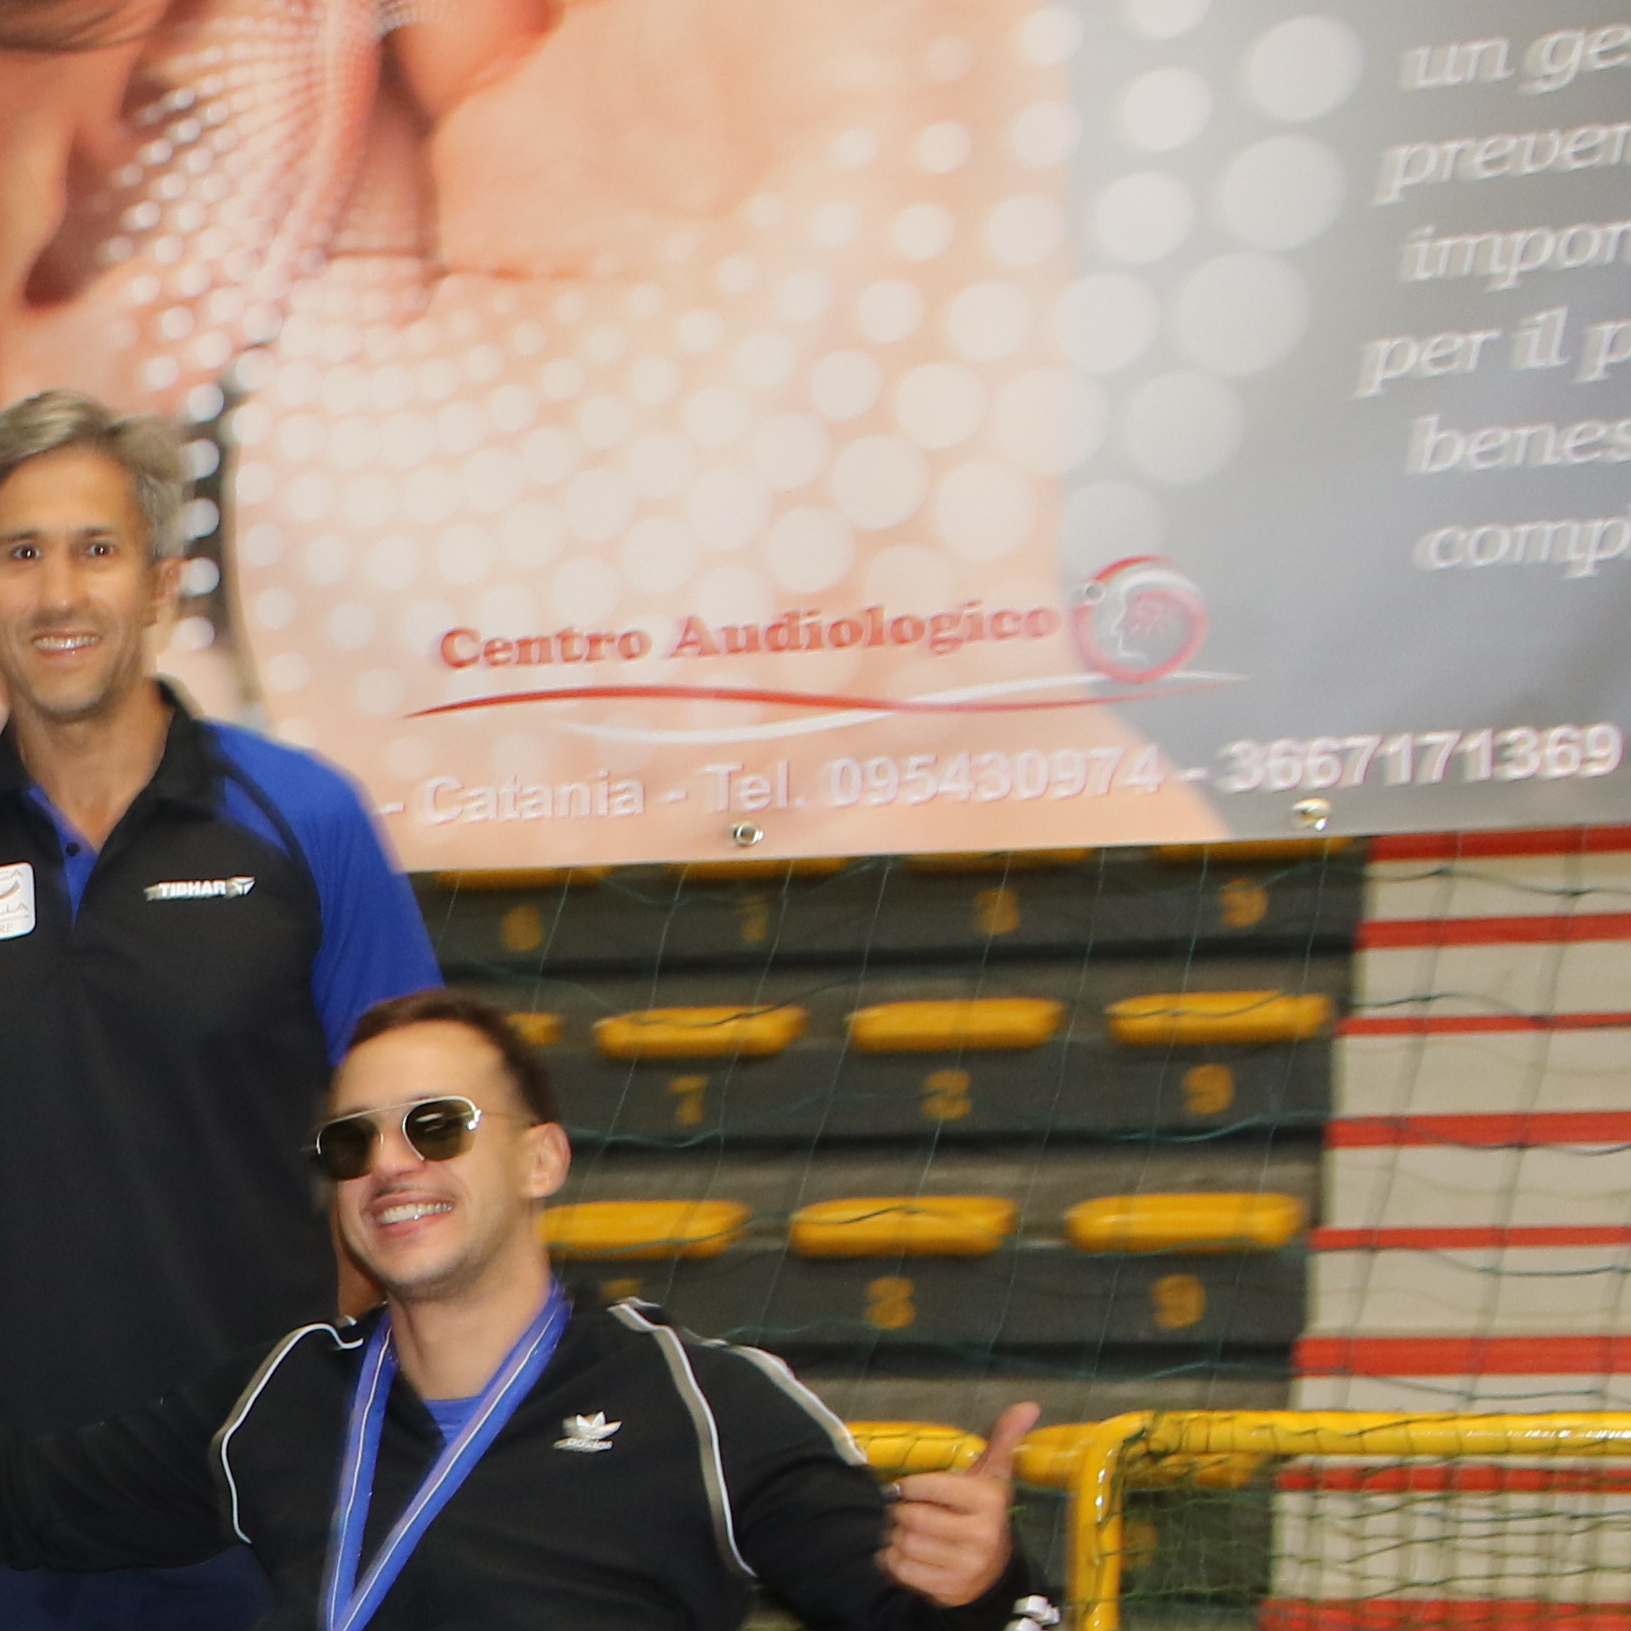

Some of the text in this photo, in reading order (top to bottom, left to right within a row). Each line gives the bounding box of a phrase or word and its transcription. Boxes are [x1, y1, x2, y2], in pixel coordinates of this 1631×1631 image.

[1402, 21, 1631, 95] un ge
[1355, 328, 1501, 400] per
[1512, 306, 1572, 372] il
[1407, 412, 1631, 476] benes
[1416, 515, 1631, 580] comp
[439, 600, 1062, 669] Centro Audiologico
[422, 770, 646, 825] Catania
[702, 759, 806, 814] Tel.
[828, 744, 1165, 806] 095430974
[1220, 722, 1623, 794] 3667171369
